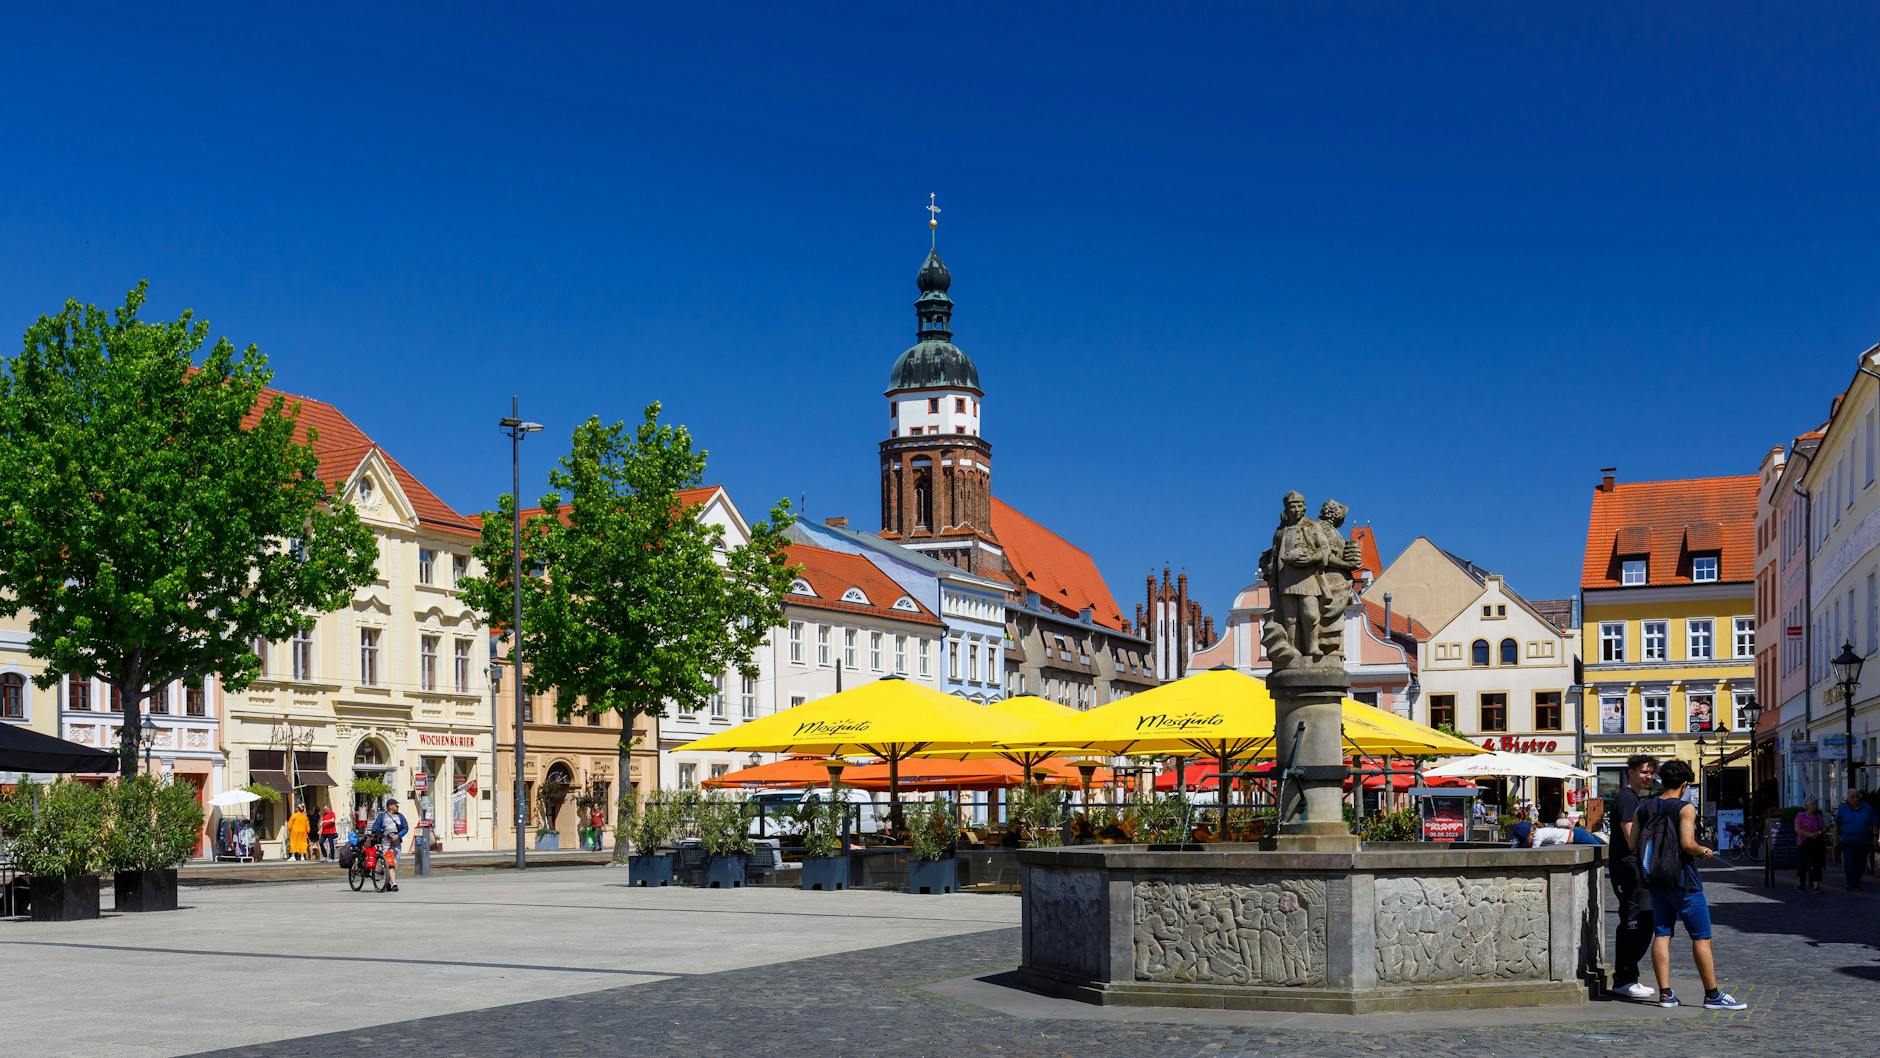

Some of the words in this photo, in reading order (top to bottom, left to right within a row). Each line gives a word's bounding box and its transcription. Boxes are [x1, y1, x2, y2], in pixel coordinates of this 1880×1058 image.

[419, 734, 475, 747] WOCHENKURIER
[1500, 736, 1557, 753] Bistro
[1640, 745, 1666, 753] GOETHE
